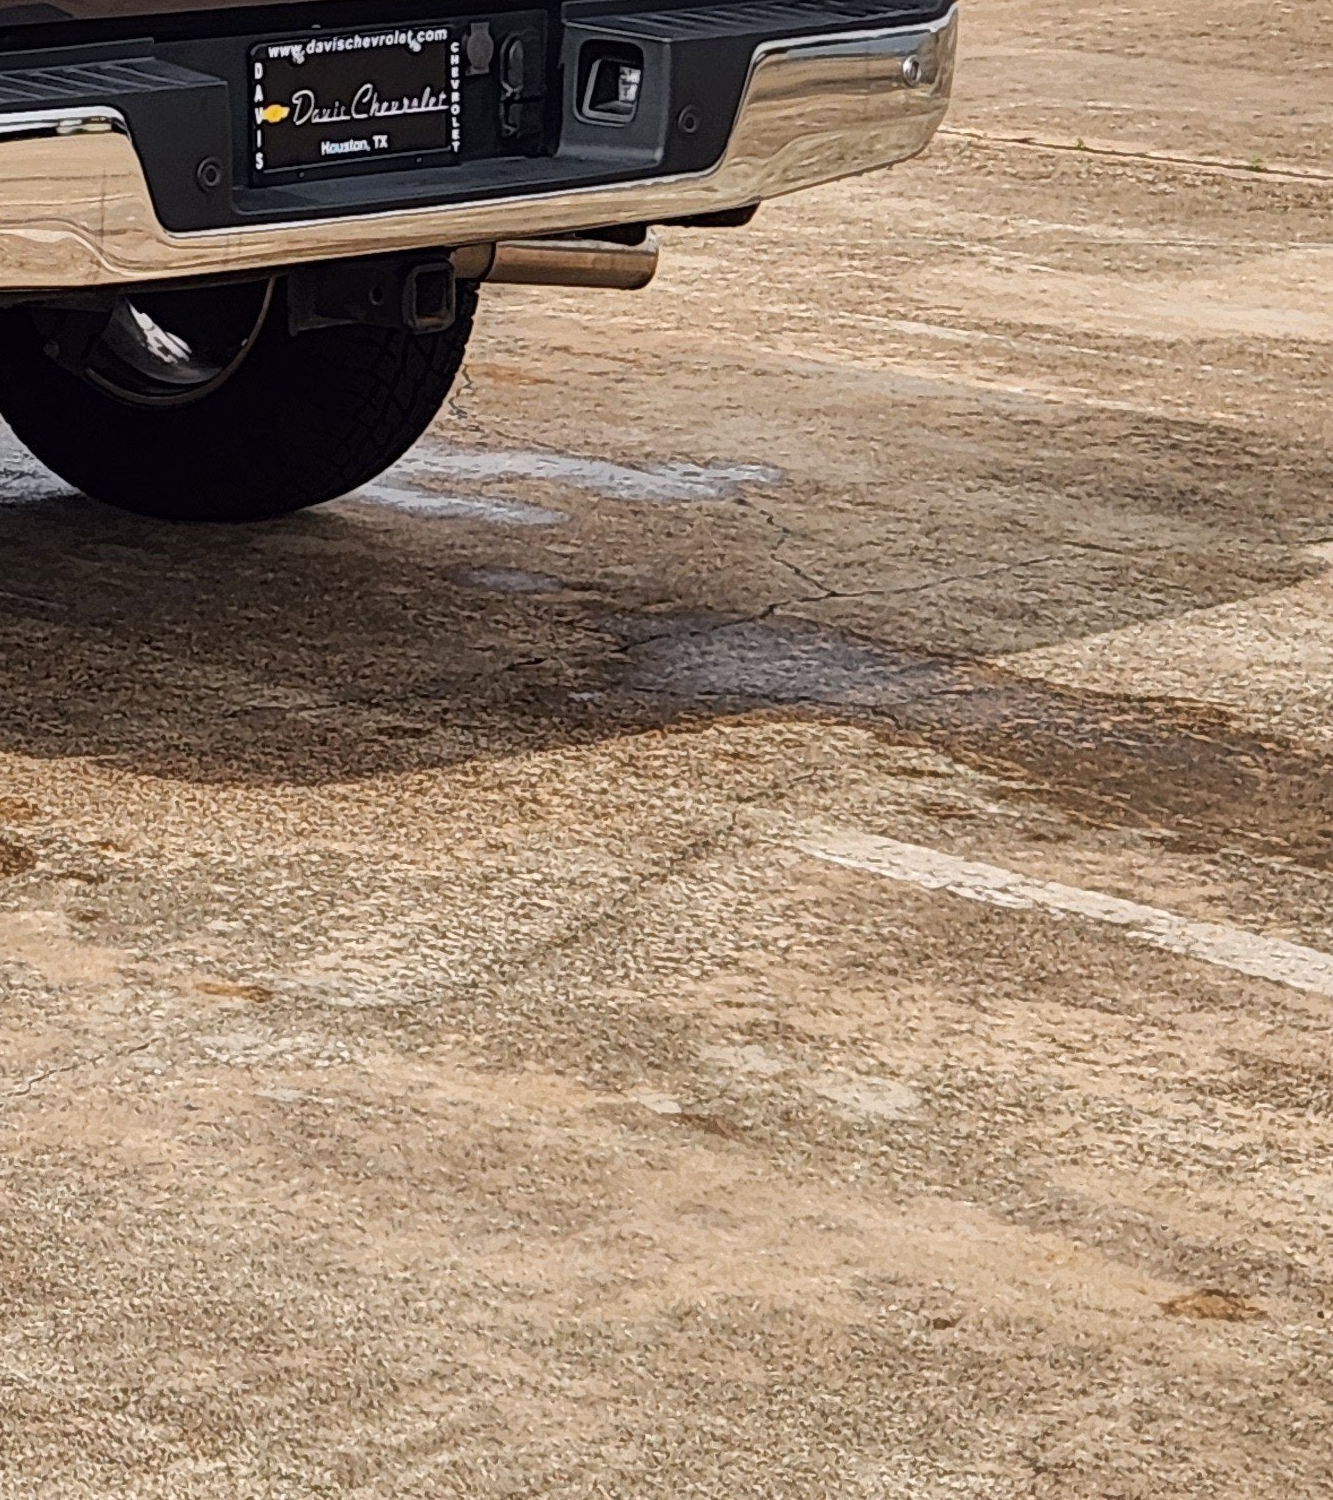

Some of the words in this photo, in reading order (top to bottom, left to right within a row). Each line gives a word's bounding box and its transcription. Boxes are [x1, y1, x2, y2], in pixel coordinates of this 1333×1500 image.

[268, 28, 448, 58] www.davischevrolet.com
[253, 62, 264, 170] DAVIS
[291, 89, 351, 126] Davis
[351, 83, 449, 119] Chevrolet
[450, 41, 461, 153] CHEVROLET
[321, 140, 370, 156] Houston,
[372, 134, 388, 149] TX
